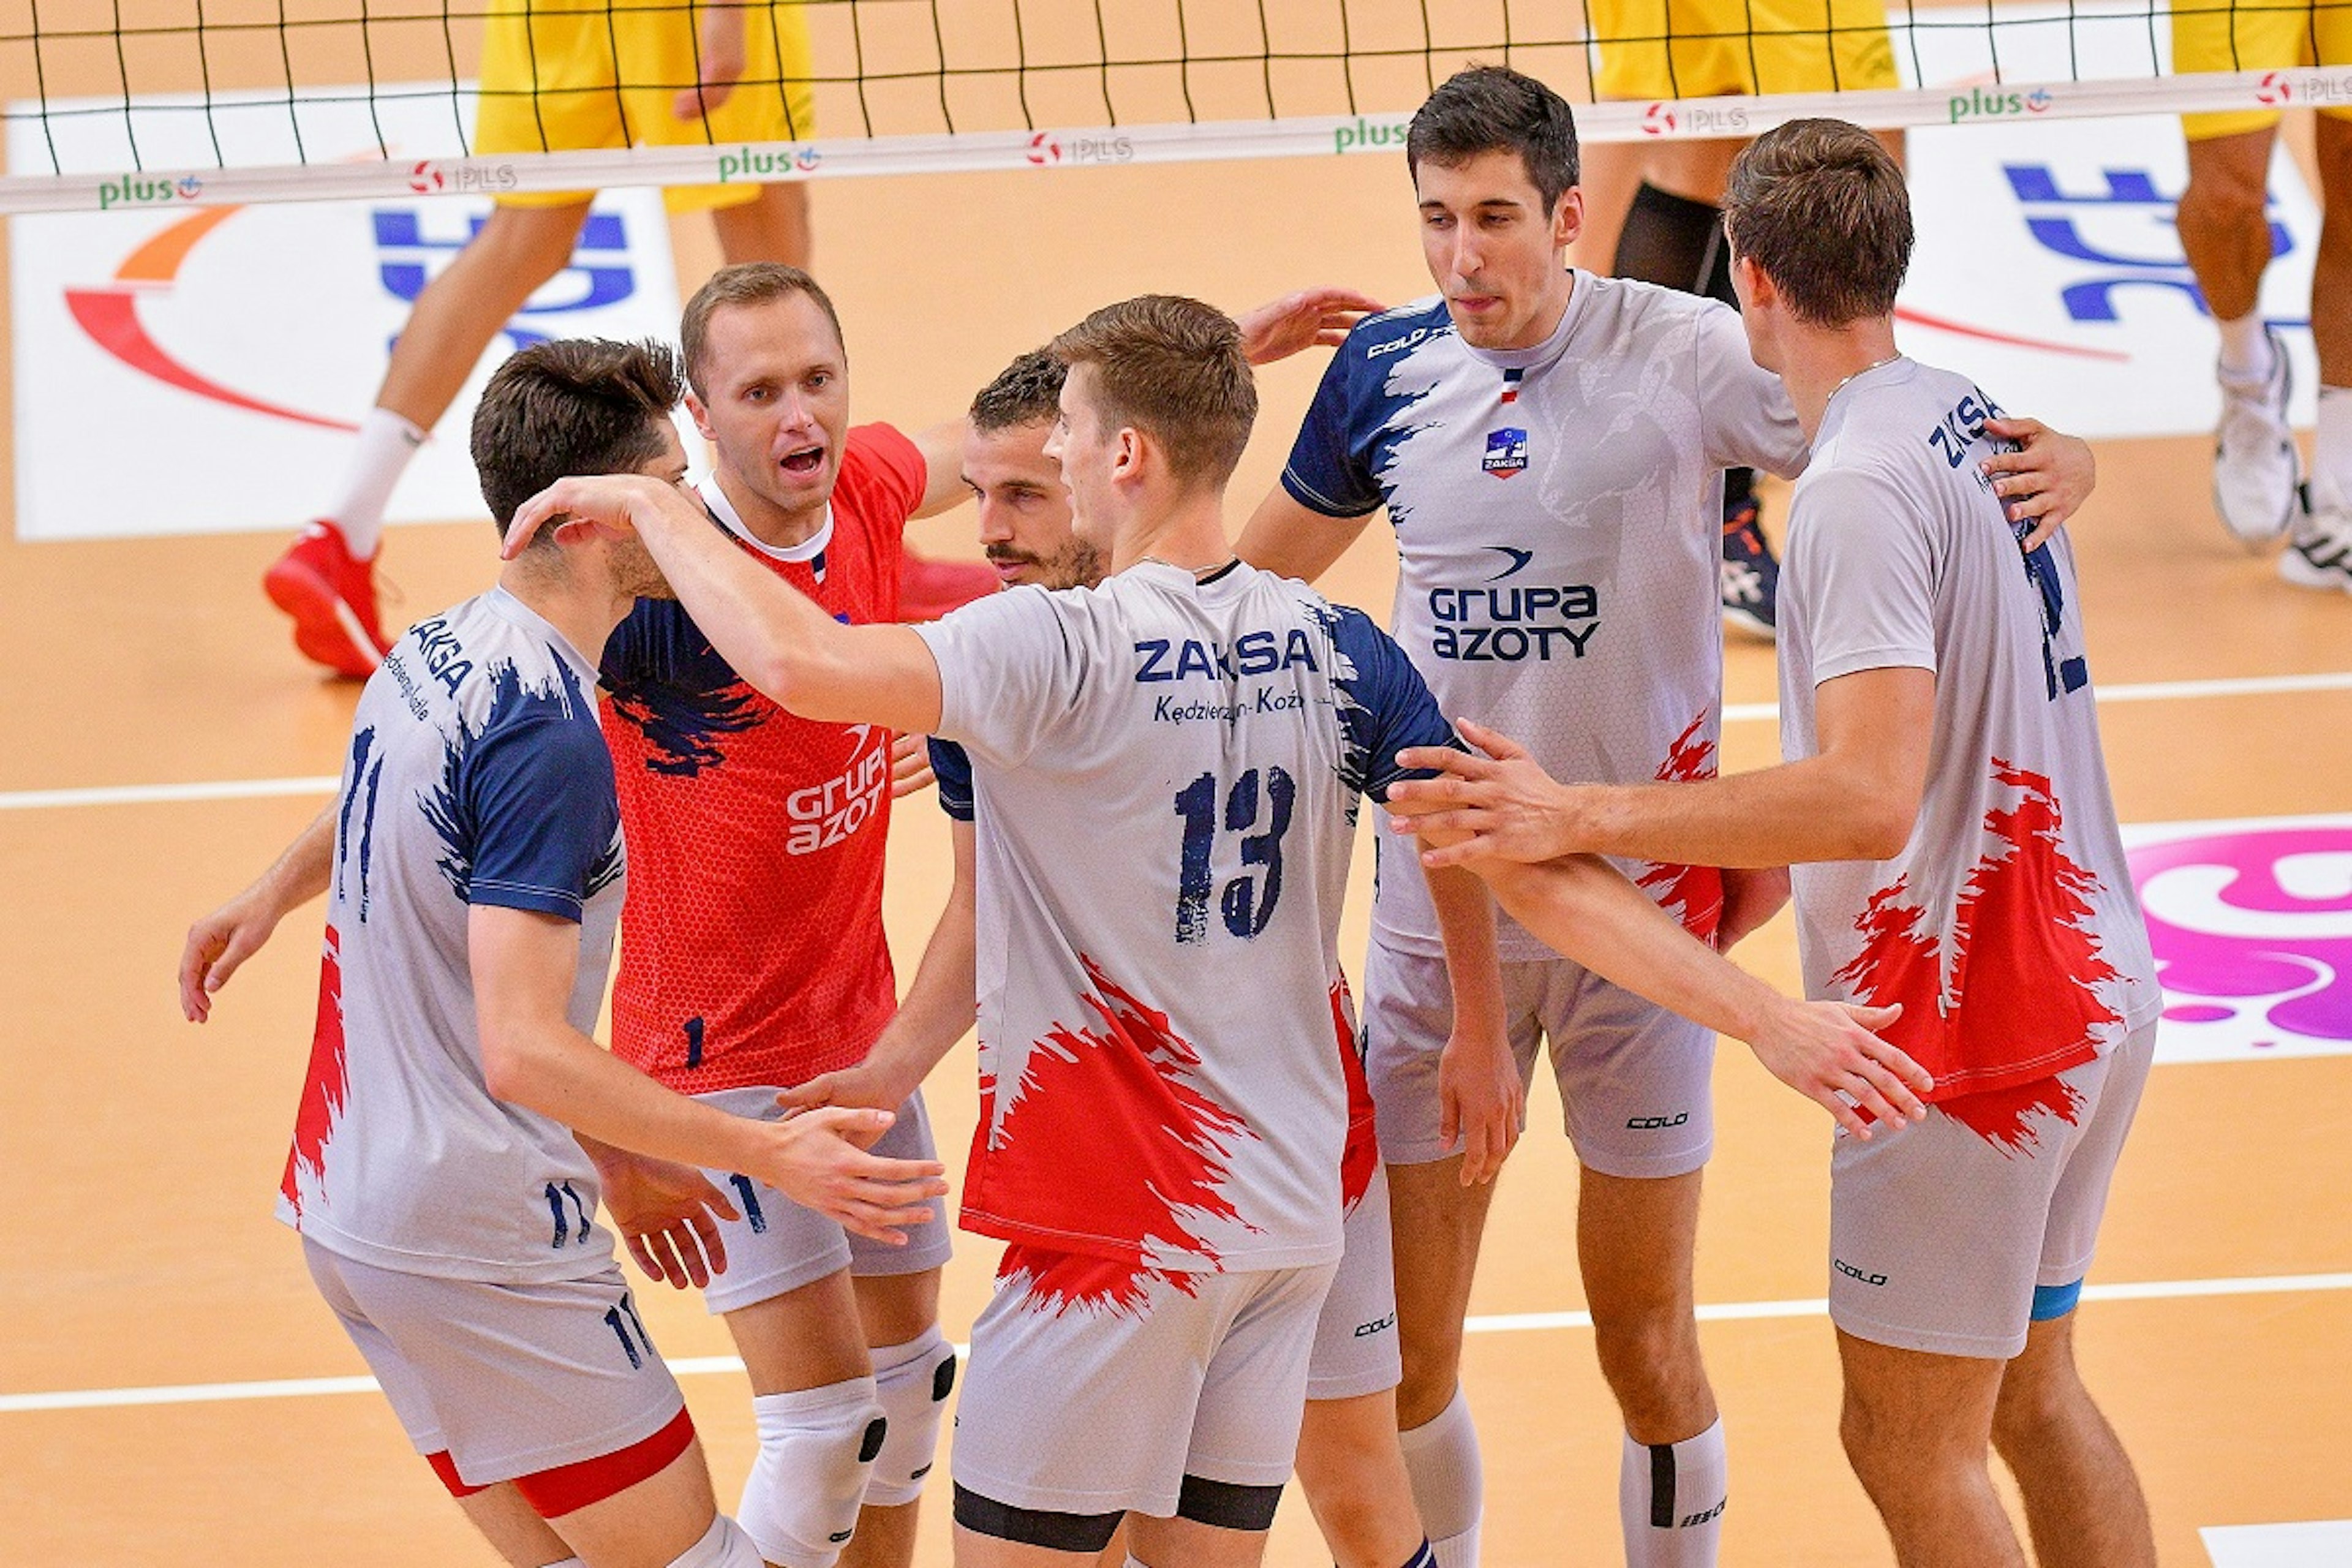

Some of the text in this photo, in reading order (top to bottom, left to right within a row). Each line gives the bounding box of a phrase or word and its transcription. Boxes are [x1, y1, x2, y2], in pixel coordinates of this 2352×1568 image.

[1950, 88, 2022, 124] plus
[1336, 118, 1408, 154] plus
[719, 147, 791, 183] plus
[100, 174, 173, 210] plus
[1367, 328, 1427, 360] COLO
[409, 612, 473, 699] AKSA
[339, 725, 385, 923] 11
[1174, 766, 1295, 944] 13
[684, 1016, 704, 1068] 1
[1627, 1114, 1689, 1128] COLO
[545, 1181, 590, 1248] 11
[729, 1172, 767, 1233] 1
[1834, 1259, 1888, 1285] COLO
[604, 1291, 653, 1370] 11
